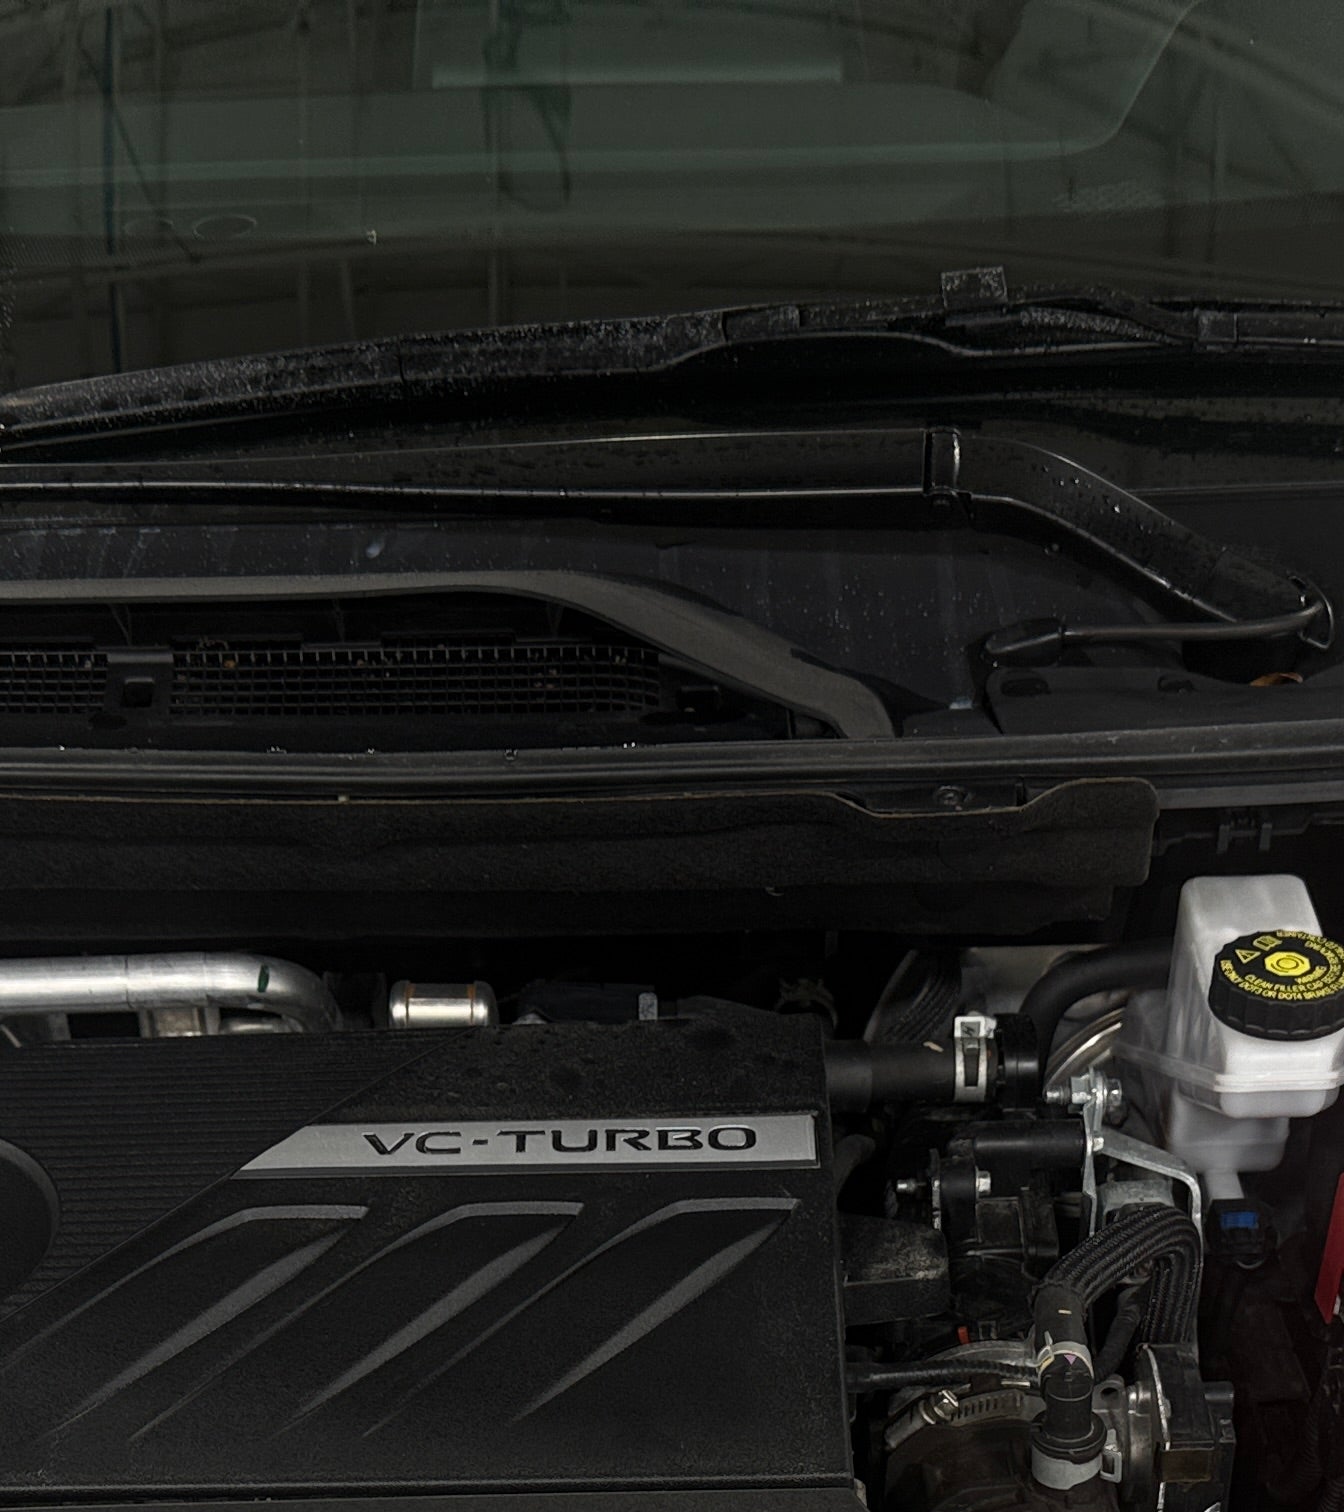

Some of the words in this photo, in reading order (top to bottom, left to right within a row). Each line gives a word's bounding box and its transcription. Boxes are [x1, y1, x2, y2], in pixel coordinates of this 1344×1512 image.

[1245, 974, 1273, 990] CLEAN
[1274, 984, 1306, 992] FILLER
[362, 1125, 757, 1156] VC-TURBO
